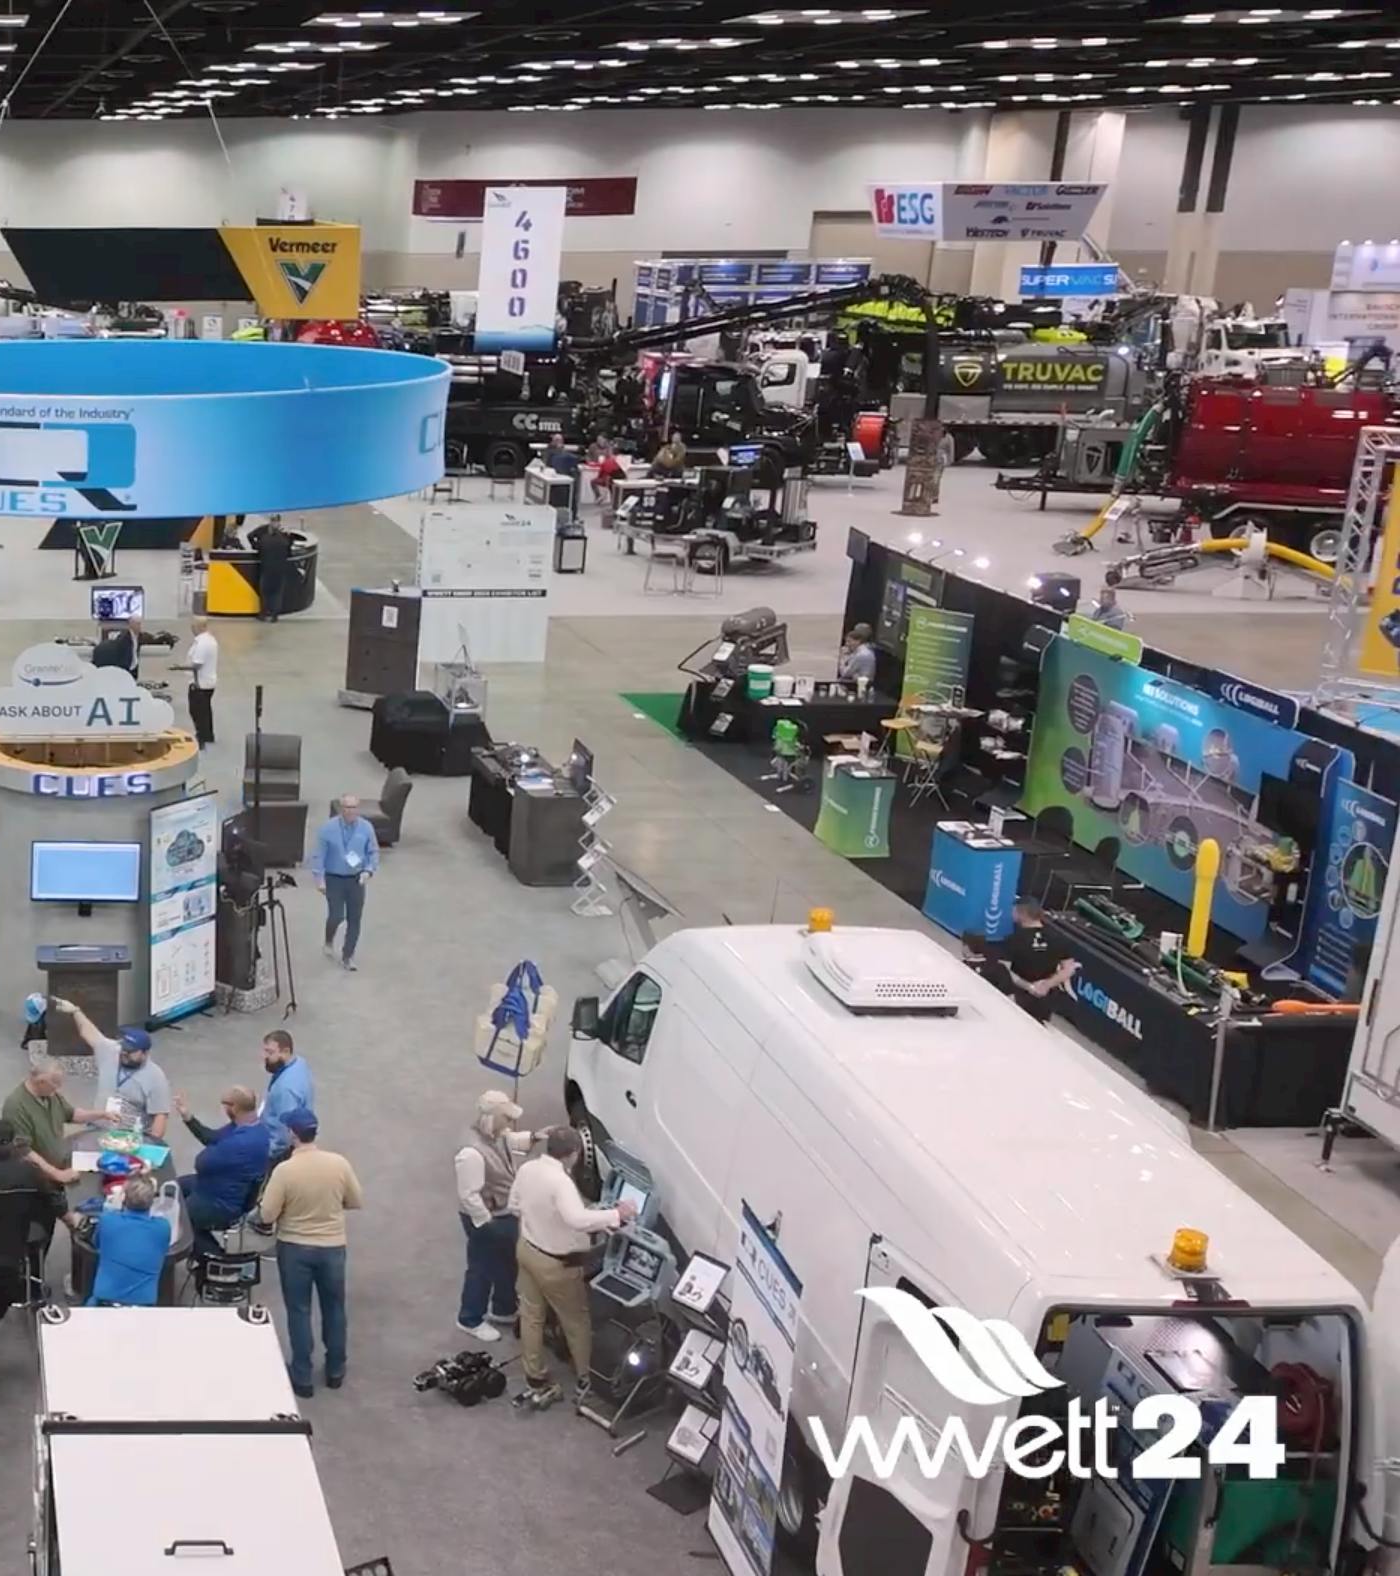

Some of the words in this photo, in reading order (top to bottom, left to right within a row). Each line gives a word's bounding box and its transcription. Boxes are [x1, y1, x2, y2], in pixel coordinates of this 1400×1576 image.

[897, 193, 935, 225] ESG
[268, 236, 338, 253] Vermeer
[509, 210, 533, 317] 4600
[1002, 362, 1104, 382] TRUVAC
[39, 407, 52, 418] of
[55, 407, 75, 419] the
[31, 705, 82, 718] ABOUT
[86, 697, 142, 727] AI
[32, 773, 153, 798] CUES
[1077, 976, 1143, 1040] LOGIBALL
